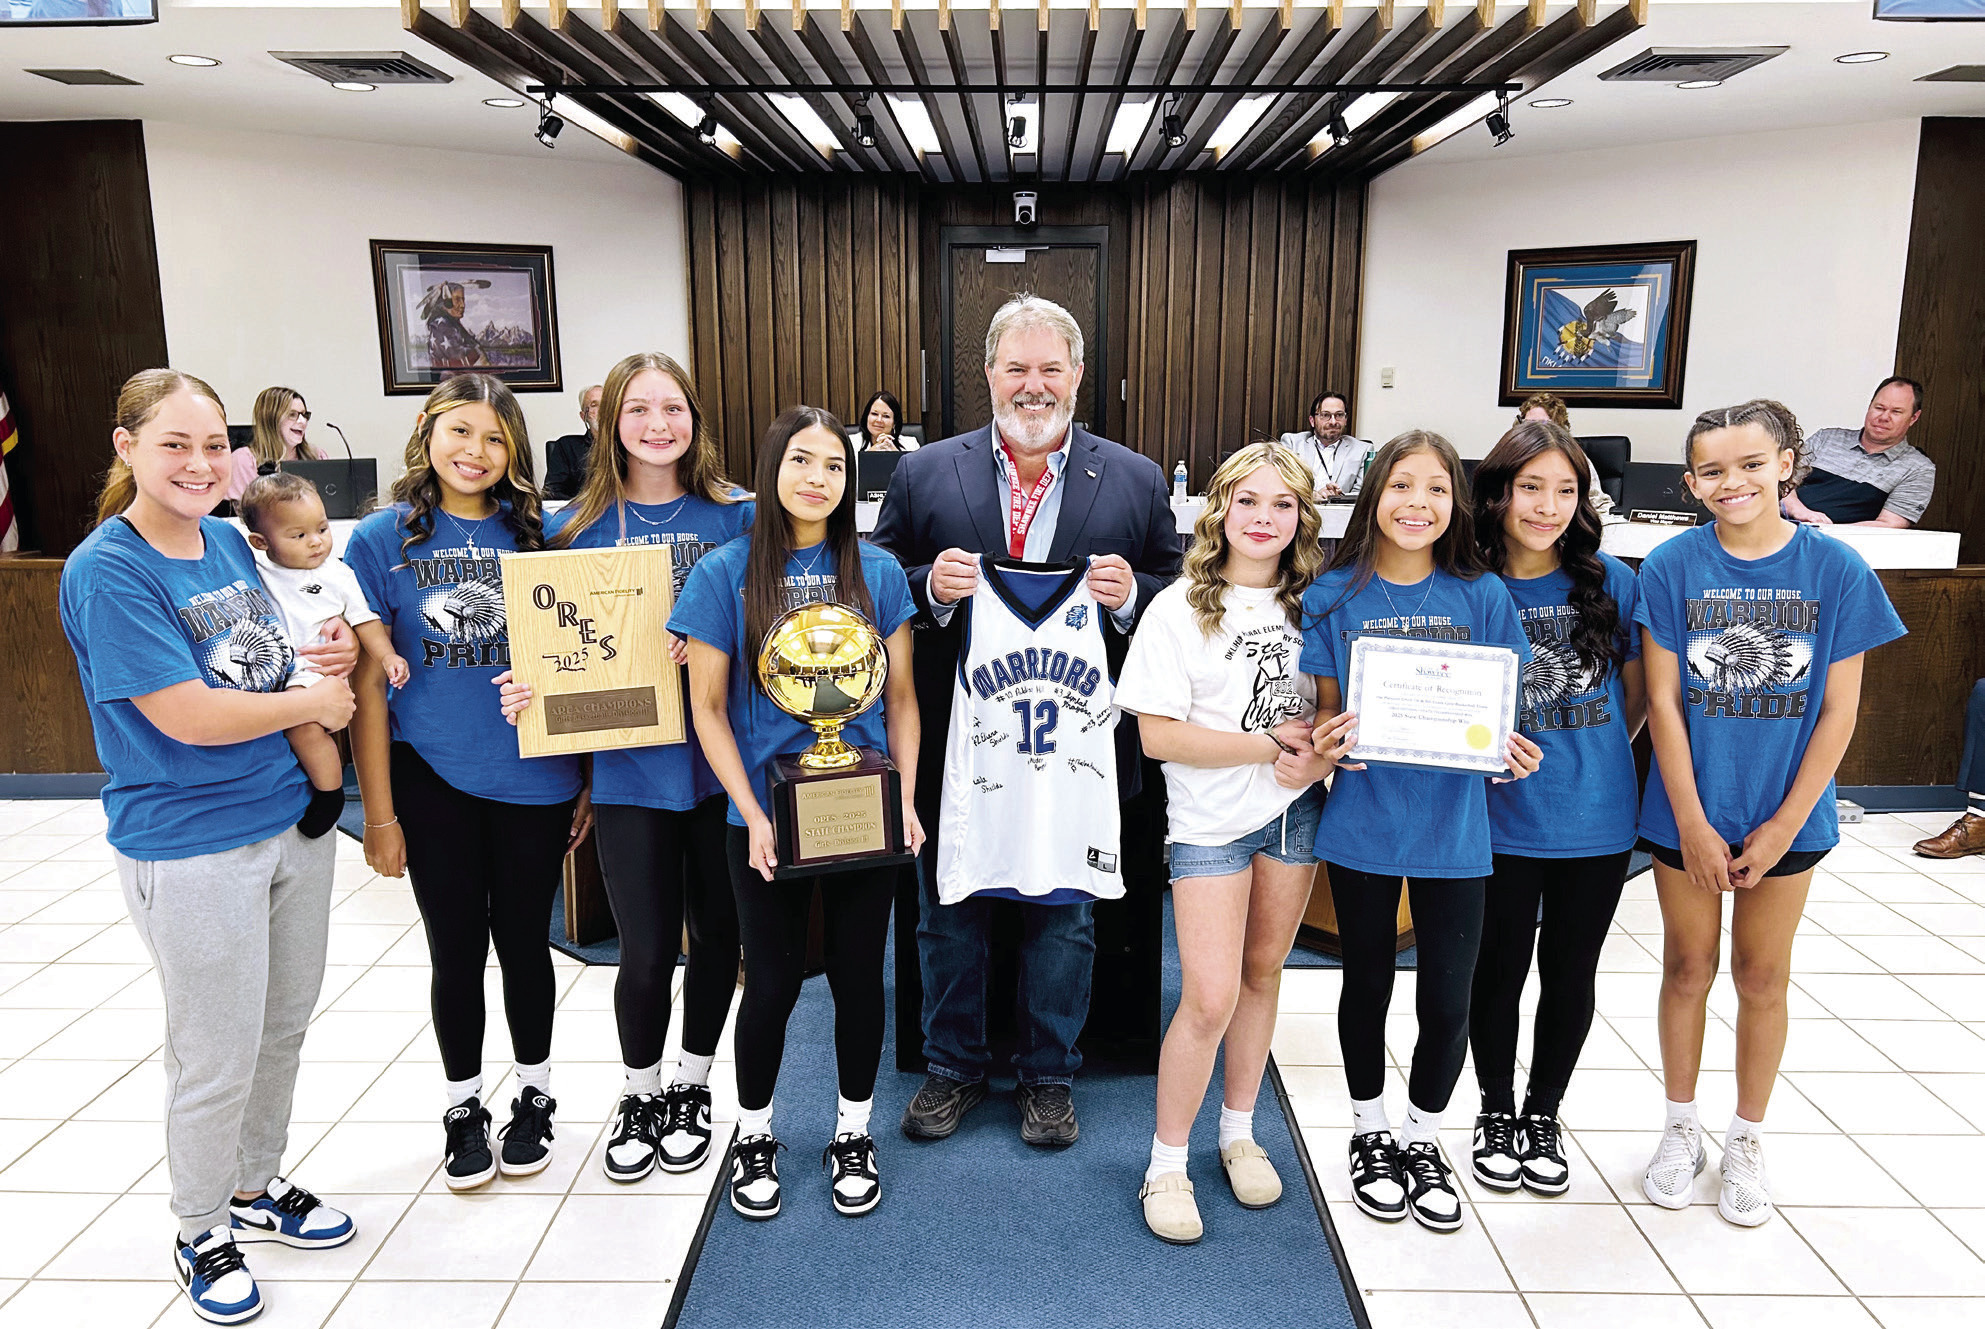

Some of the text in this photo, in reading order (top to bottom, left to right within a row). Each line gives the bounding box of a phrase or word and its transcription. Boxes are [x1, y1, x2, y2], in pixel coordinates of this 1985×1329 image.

[1013, 491, 1022, 509] FIRE
[1017, 499, 1038, 535] SHAWNEE
[1031, 484, 1046, 501] FIRE
[1636, 512, 1690, 522] Daniel Matthews
[651, 533, 661, 544] TO
[661, 533, 676, 543] OUR
[676, 532, 699, 542] HOUSE
[432, 547, 469, 559] WELCOME
[480, 547, 496, 558] OUR
[795, 575, 806, 587] TO
[1702, 588, 1802, 600] WELCOME TO OUR HOUSE
[1527, 609, 1538, 620] TO
[1539, 606, 1555, 618] OUR
[1685, 598, 1821, 635] WARRIOR
[532, 584, 618, 662] ORES
[1362, 616, 1399, 630] WELCOME
[1411, 615, 1427, 627] OUR
[1428, 615, 1452, 627] HOUSE
[554, 647, 589, 671] 2025
[972, 647, 1101, 701] WARRIORS
[1382, 680, 1422, 692] Certificate
[1436, 685, 1483, 697] Recognition
[551, 698, 653, 716] AREA CHAMPIONS
[1519, 692, 1611, 733] RIDE
[1012, 699, 1060, 756] 12
[843, 811, 867, 820] 2025
[805, 822, 876, 838] STATE CHAMPION
[814, 840, 831, 849] Girls
